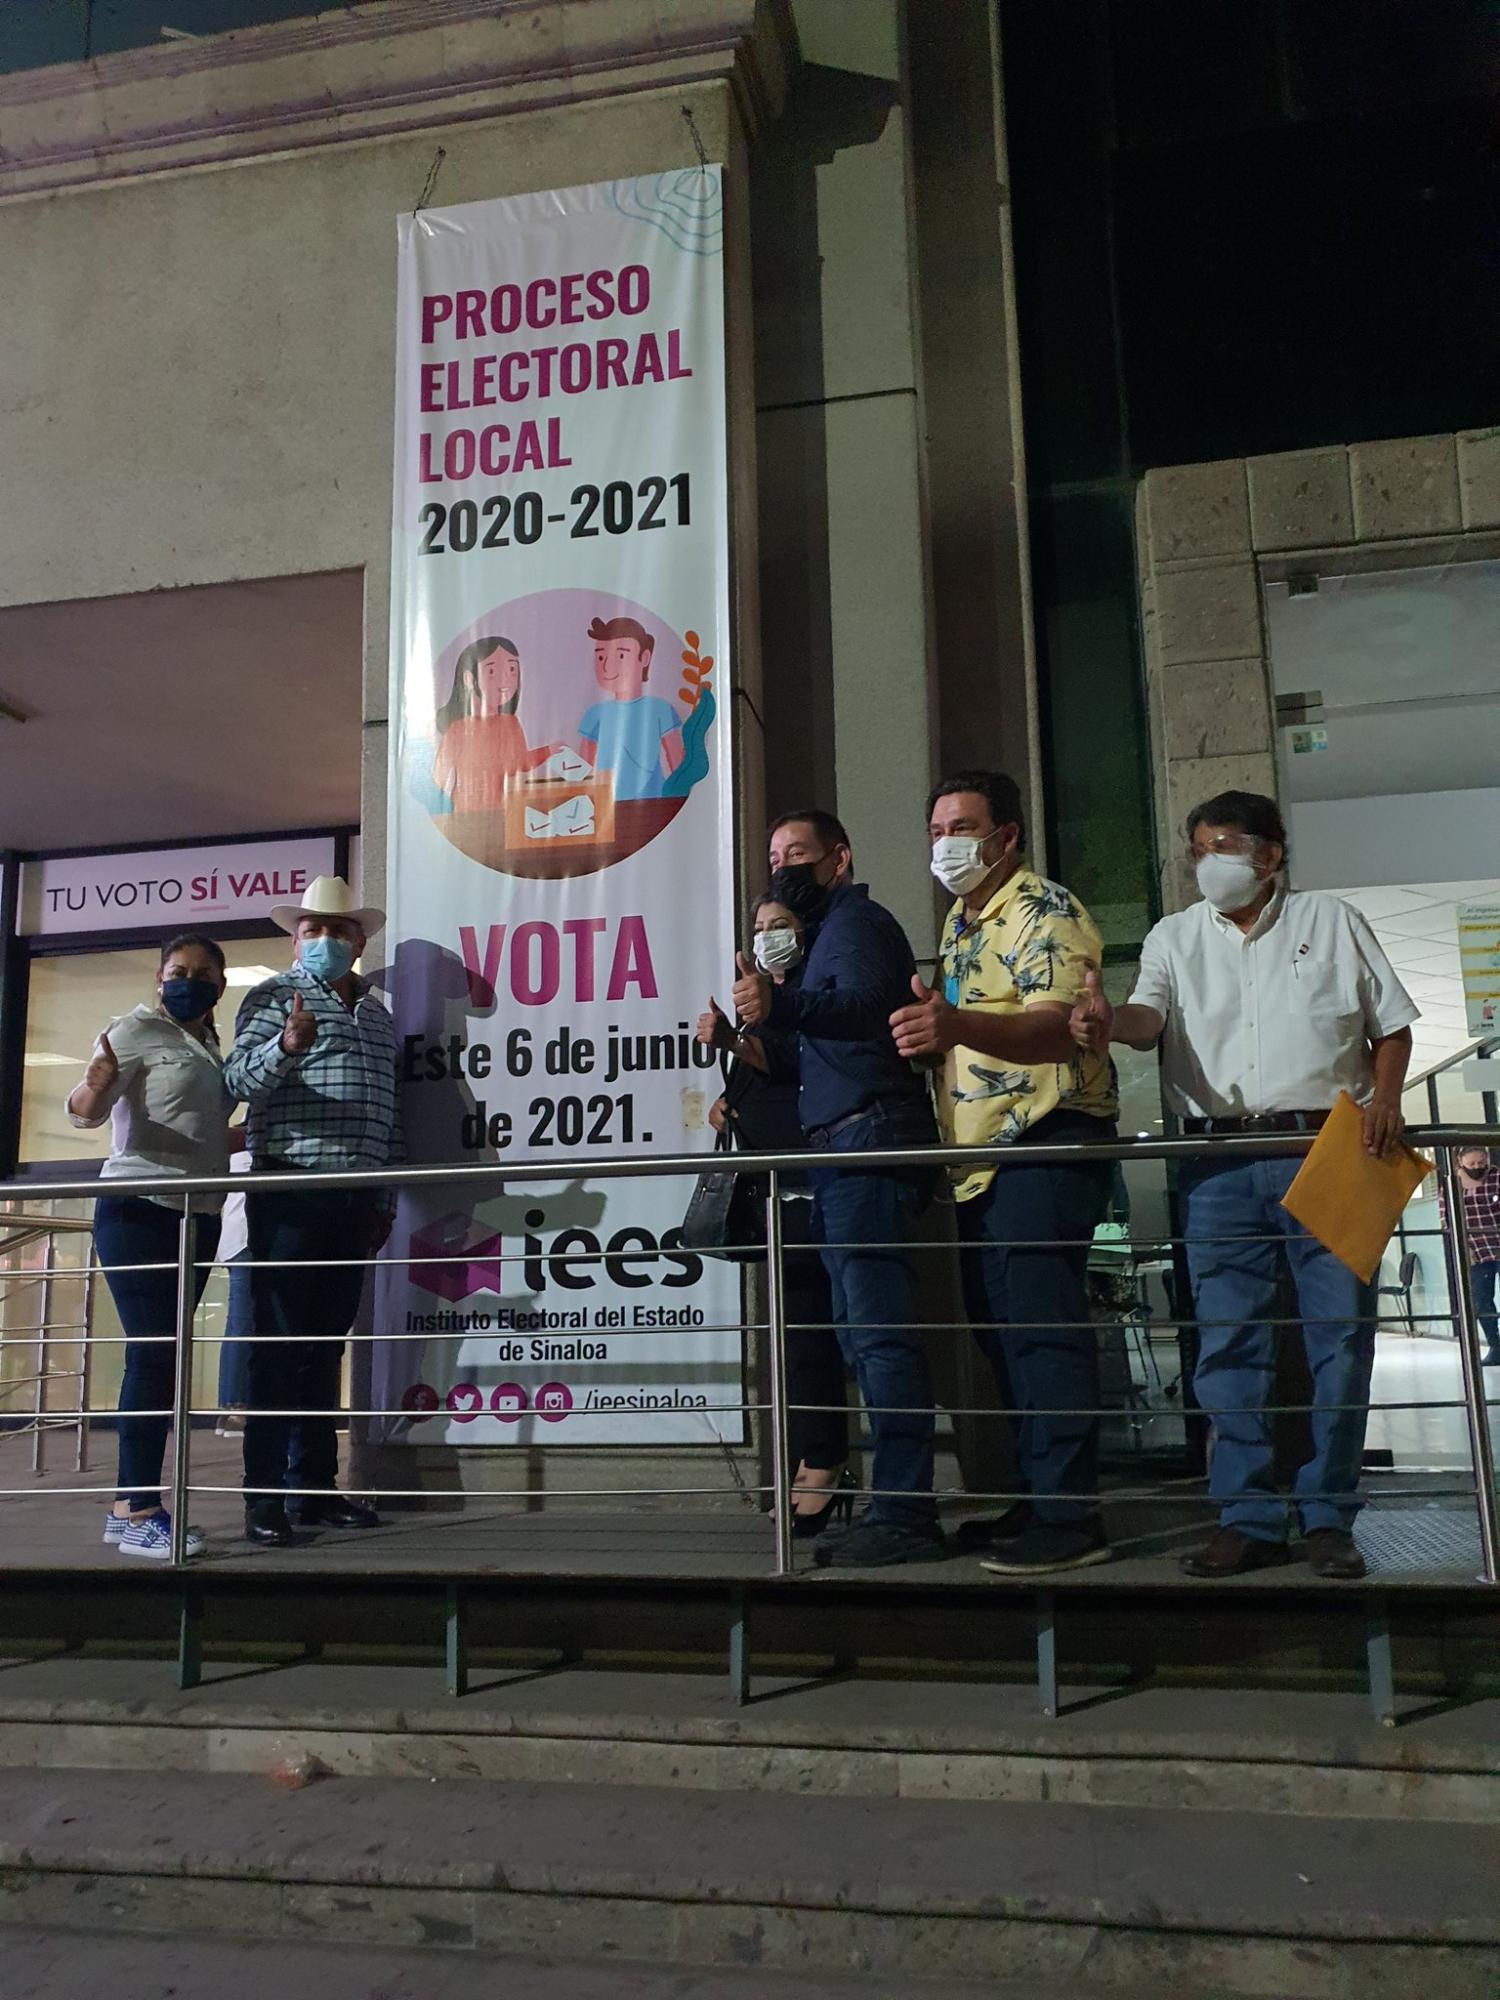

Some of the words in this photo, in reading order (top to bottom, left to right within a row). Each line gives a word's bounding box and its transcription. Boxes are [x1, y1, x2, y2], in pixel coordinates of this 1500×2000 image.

[421, 264, 651, 344] PROCESO
[420, 328, 693, 413] ELECTORAL
[418, 416, 572, 483] LOCAL
[417, 472, 691, 556] 2020-2021
[47, 886, 86, 912] TU
[96, 878, 183, 908] VOTO
[190, 867, 217, 901] SÍ
[227, 869, 306, 898] VALE
[458, 915, 659, 1008] VOTA
[402, 1032, 491, 1082] Este
[506, 1028, 533, 1078] 6
[545, 1026, 595, 1075] de
[604, 1022, 717, 1083] junio
[461, 1100, 513, 1149] de
[528, 1093, 653, 1147] 2021.
[524, 1208, 704, 1291] iees
[406, 1309, 491, 1331] Instituto
[498, 1307, 587, 1330] Electoral
[594, 1306, 626, 1327] del
[633, 1304, 705, 1327] Estado
[499, 1340, 523, 1361] de
[530, 1339, 608, 1361] Sinaloa
